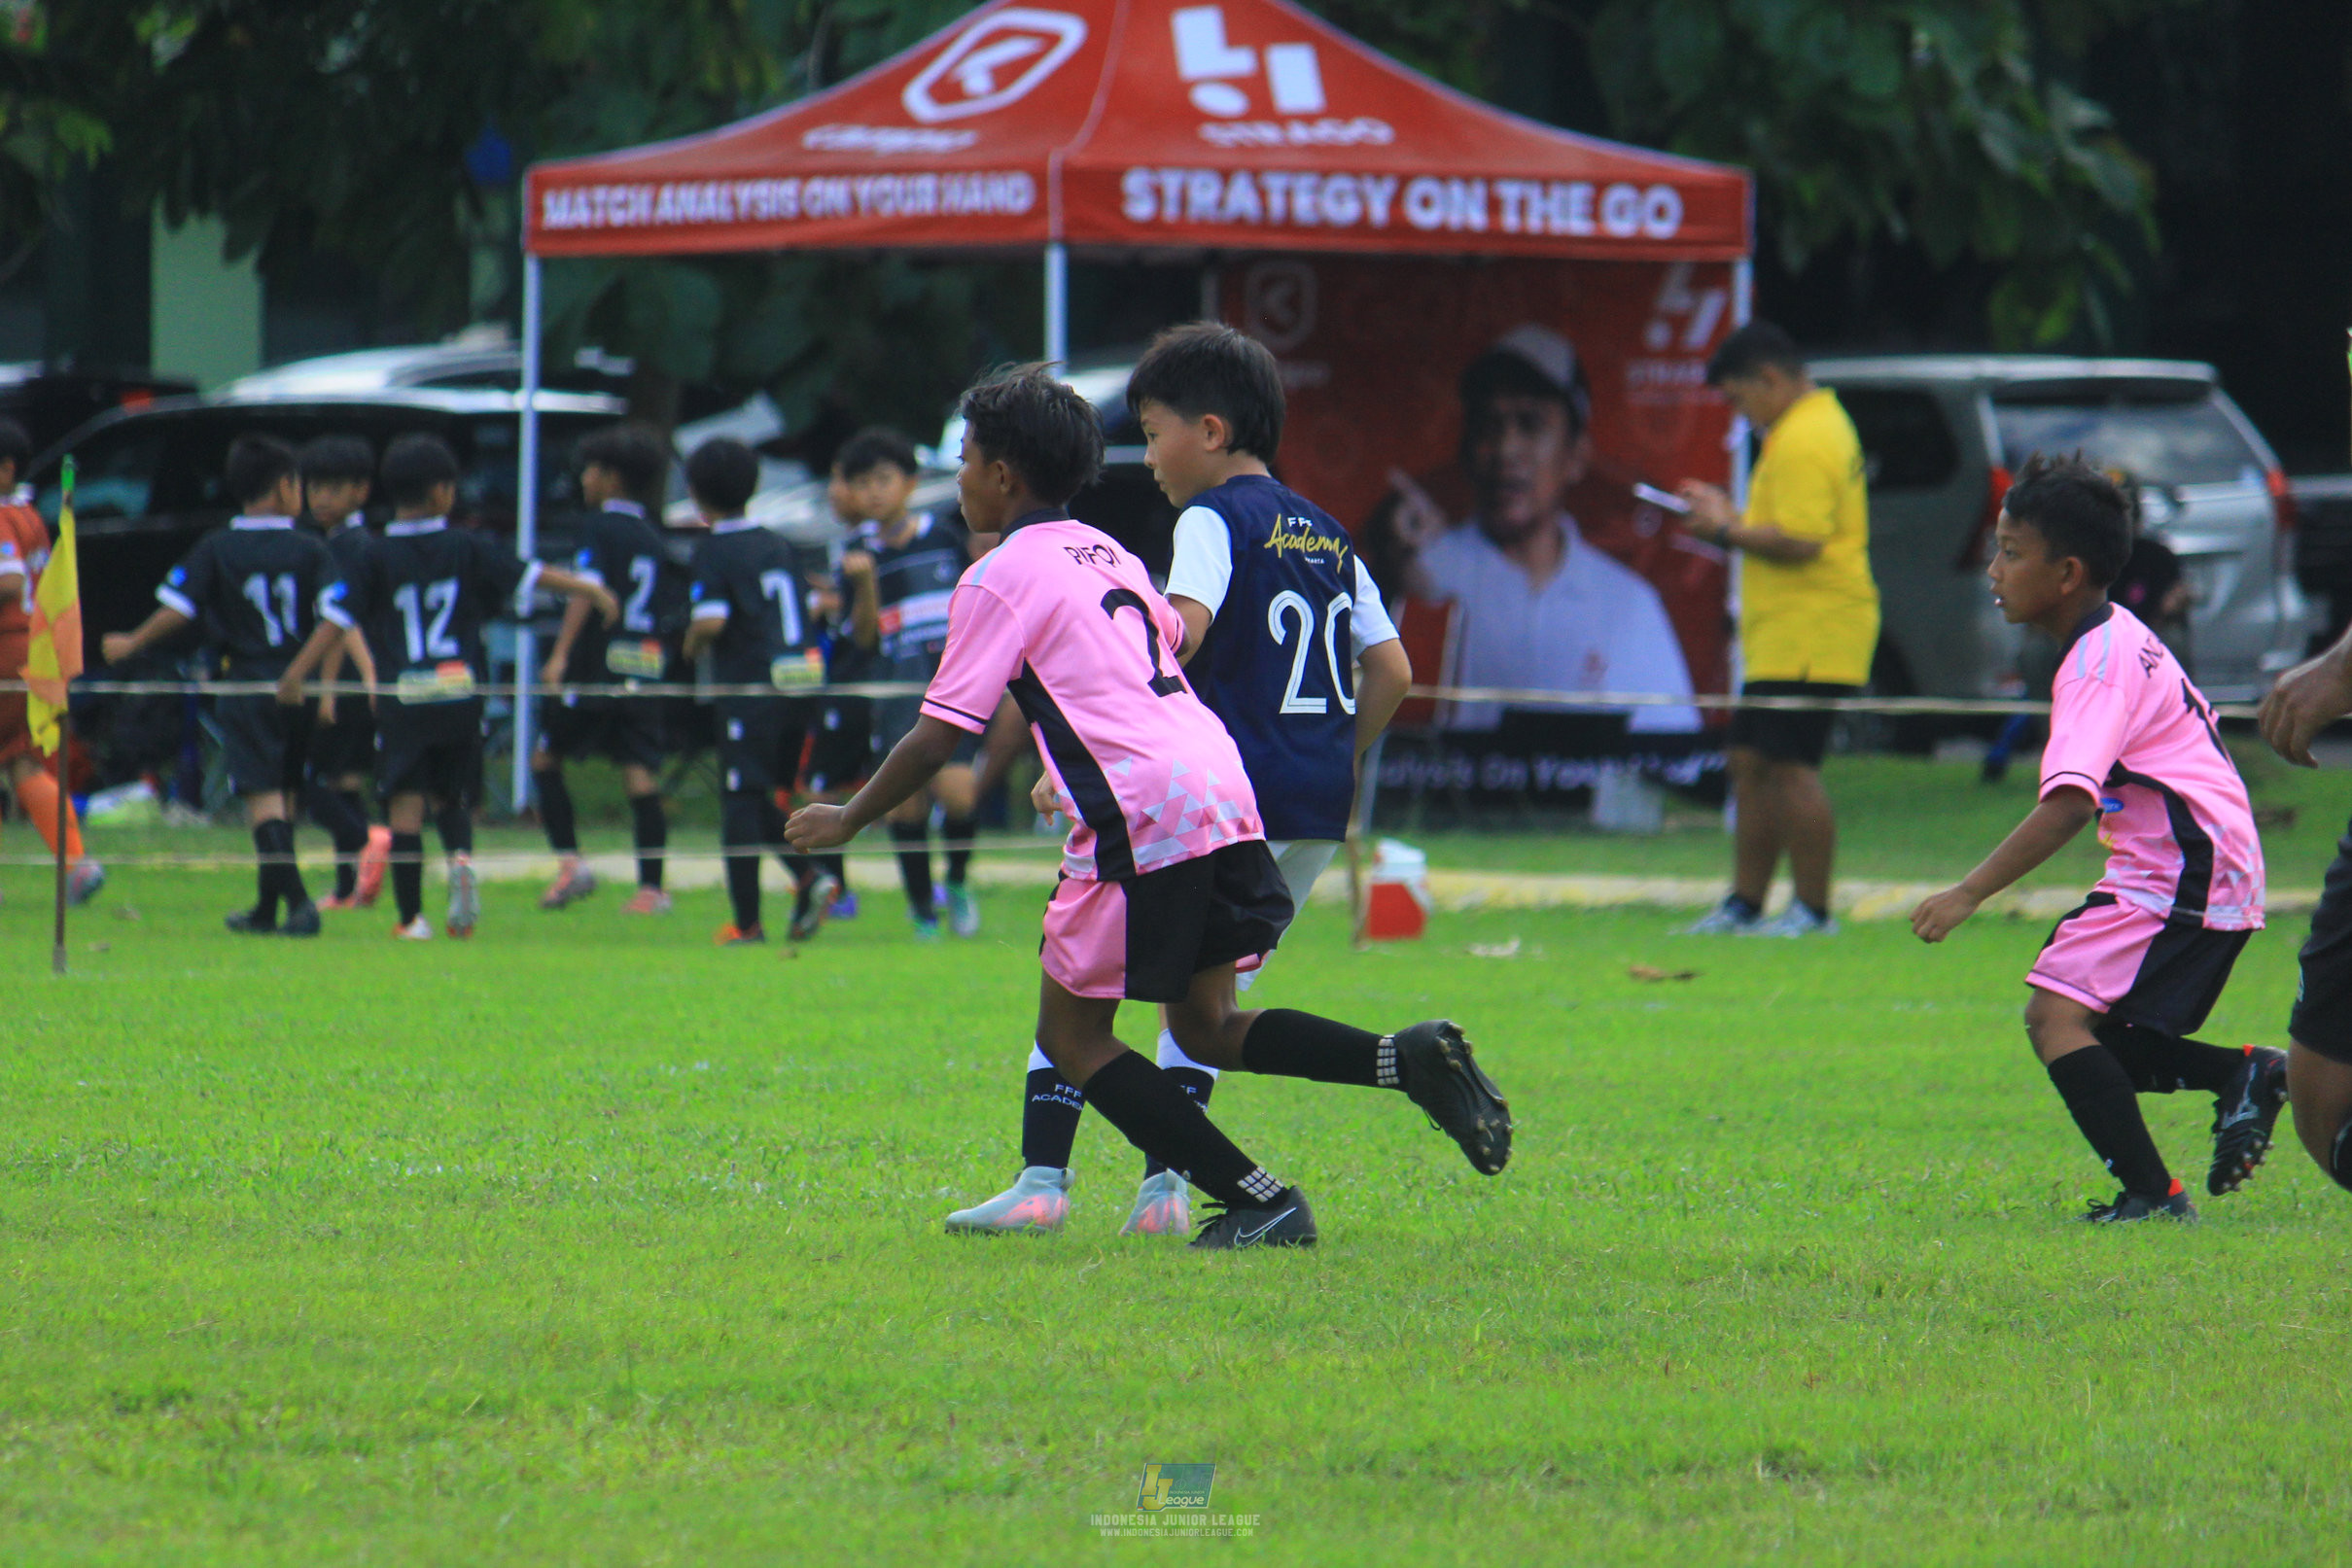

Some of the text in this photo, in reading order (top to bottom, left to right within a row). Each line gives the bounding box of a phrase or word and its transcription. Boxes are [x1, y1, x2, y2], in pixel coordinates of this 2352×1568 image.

[541, 169, 1037, 230] MATCH ANALYSIS ON YOUR HAND
[1120, 165, 1684, 240] STRATEGY ON THE GO
[1263, 512, 1349, 575] Academy
[242, 572, 298, 647] 11
[393, 576, 460, 663] 12
[623, 554, 656, 633] 2
[1100, 588, 1188, 698] 2
[1267, 589, 1356, 714] 20
